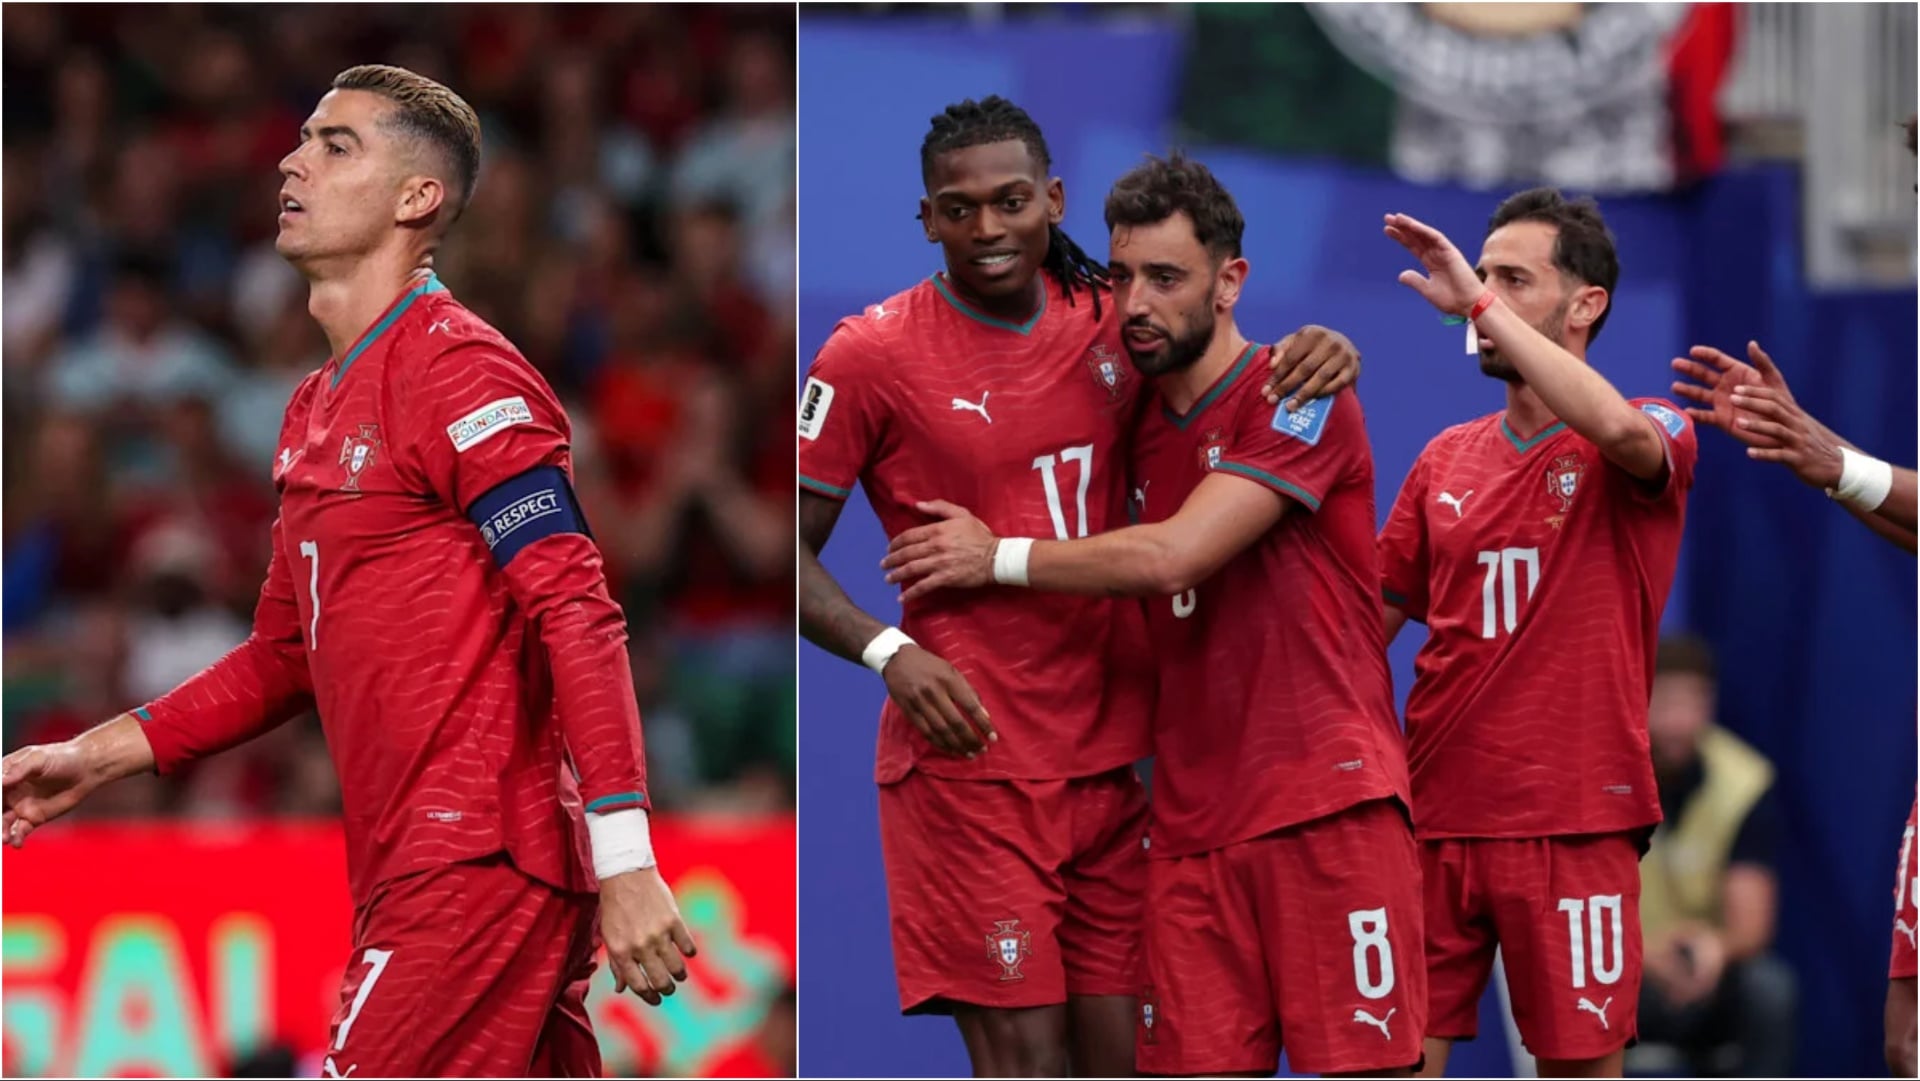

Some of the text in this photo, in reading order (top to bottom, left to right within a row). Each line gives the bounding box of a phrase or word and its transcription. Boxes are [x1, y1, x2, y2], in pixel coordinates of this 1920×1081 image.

[452, 405, 528, 443] FOUNDATION
[494, 494, 556, 533] RESPECT
[1032, 444, 1094, 541] 17
[300, 540, 320, 651] 7
[1476, 546, 1541, 639] 10
[1348, 906, 1396, 1000] 8
[1557, 894, 1624, 989] 10
[333, 947, 394, 1050] 7
